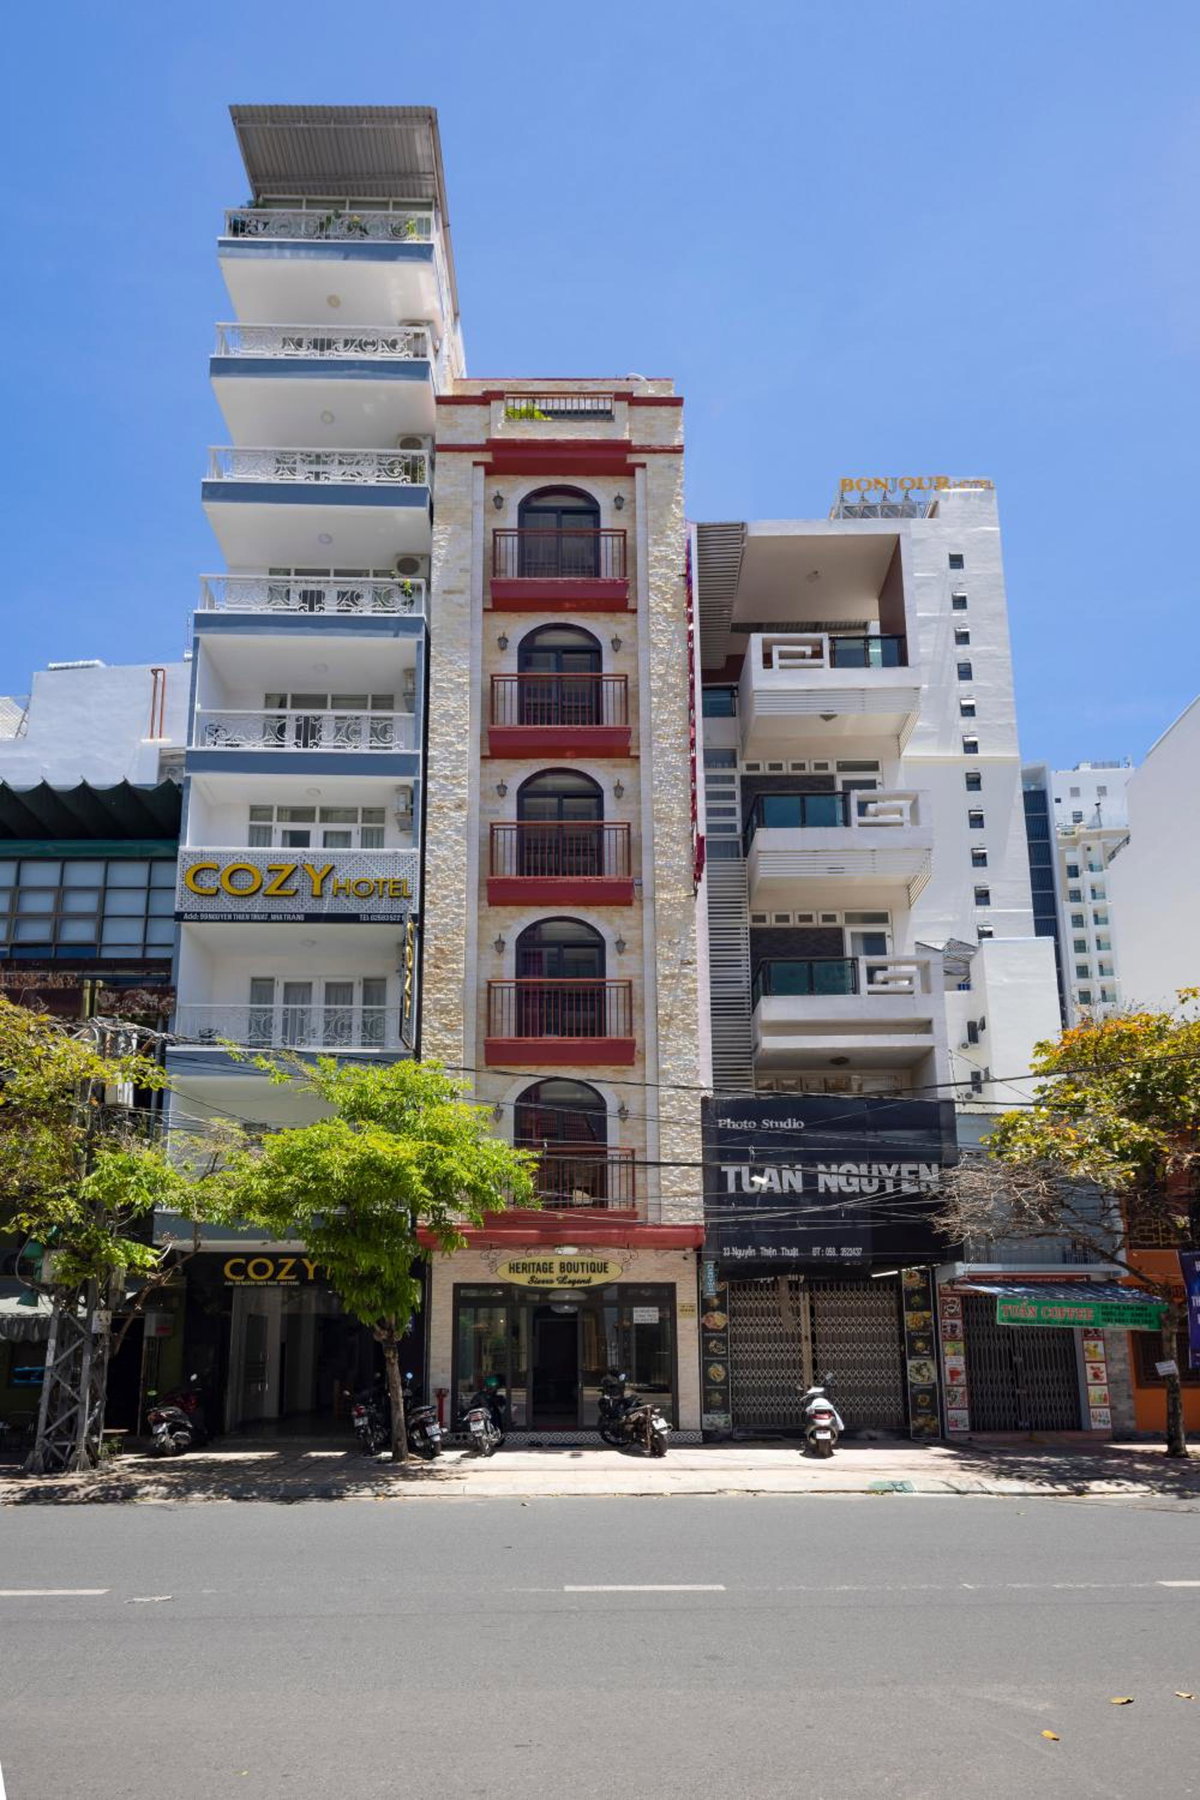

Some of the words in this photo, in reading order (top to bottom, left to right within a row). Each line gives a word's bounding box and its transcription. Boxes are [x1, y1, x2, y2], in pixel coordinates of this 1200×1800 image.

[840, 476, 951, 494] BONJOUR
[184, 861, 334, 897] COZY
[332, 876, 413, 899] HOTEL
[718, 1118, 757, 1130] Photo
[761, 1118, 805, 1130] Studio
[817, 1163, 941, 1194] NGUYEN
[223, 1257, 320, 1281] COZY
[508, 1261, 554, 1274] HERITAGE
[559, 1261, 609, 1274] BOUTIQUE
[1041, 1306, 1094, 1321] COFFEE
